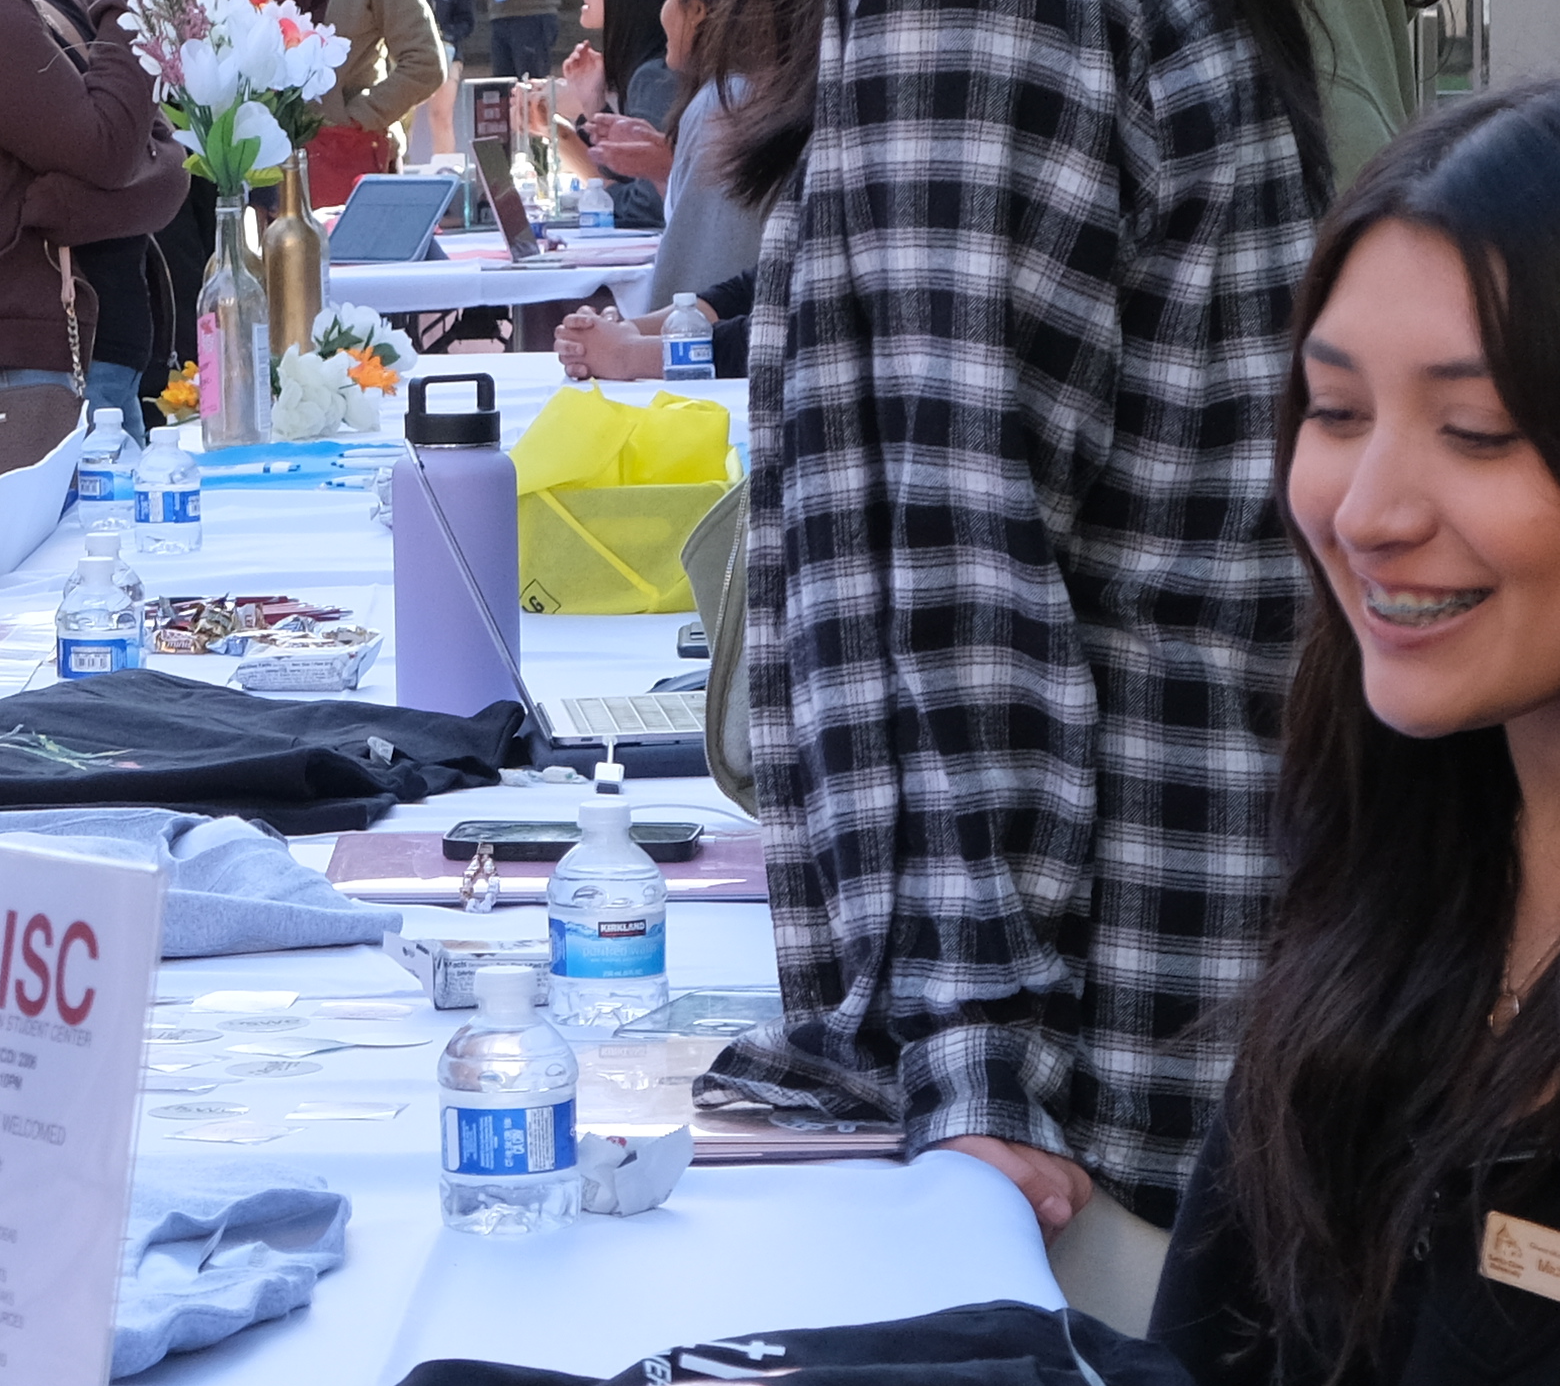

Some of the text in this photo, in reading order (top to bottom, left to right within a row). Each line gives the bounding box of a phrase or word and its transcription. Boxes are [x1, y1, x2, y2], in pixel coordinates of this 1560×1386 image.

[600, 922, 645, 933] KIRKLAND
[7, 1014, 49, 1039] STUDENT
[50, 1024, 92, 1048] CENTER
[3, 1115, 67, 1146] WELCOMED
